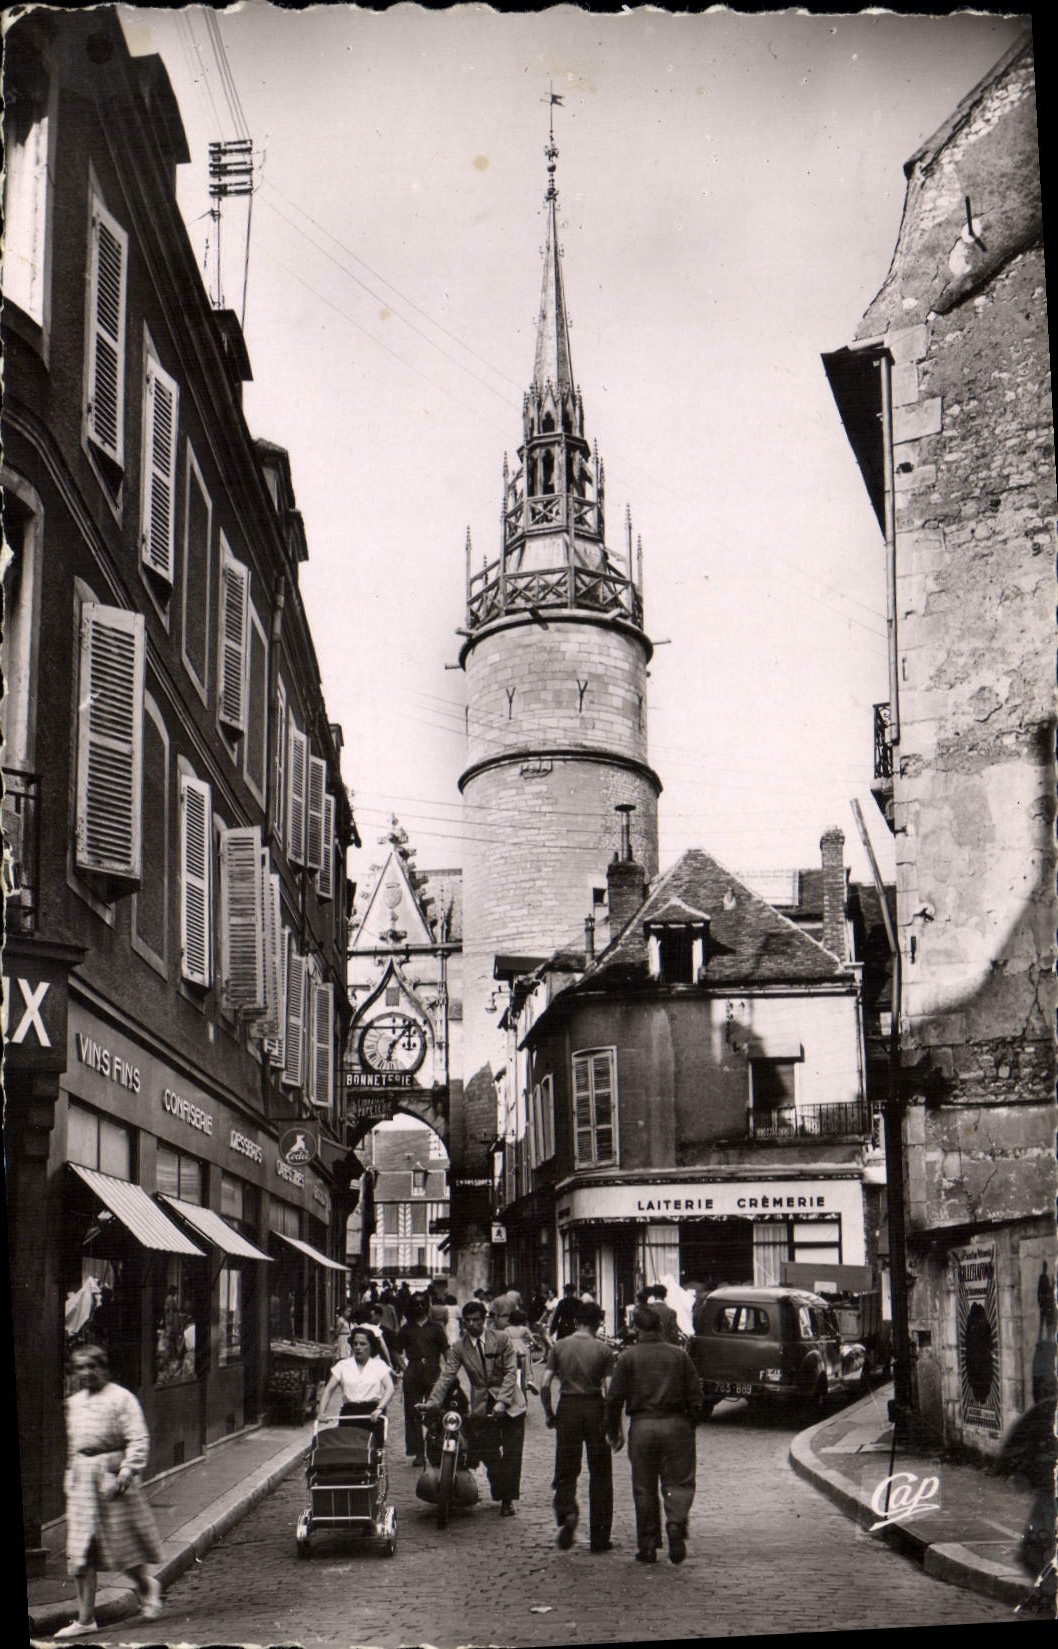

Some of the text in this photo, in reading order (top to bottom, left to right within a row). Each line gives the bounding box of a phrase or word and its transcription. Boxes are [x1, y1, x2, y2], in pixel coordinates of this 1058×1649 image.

[80, 1032, 262, 1163] VINS FINS CONFISERIE DESSERTS
[637, 1199, 714, 1211] LAITERIE
